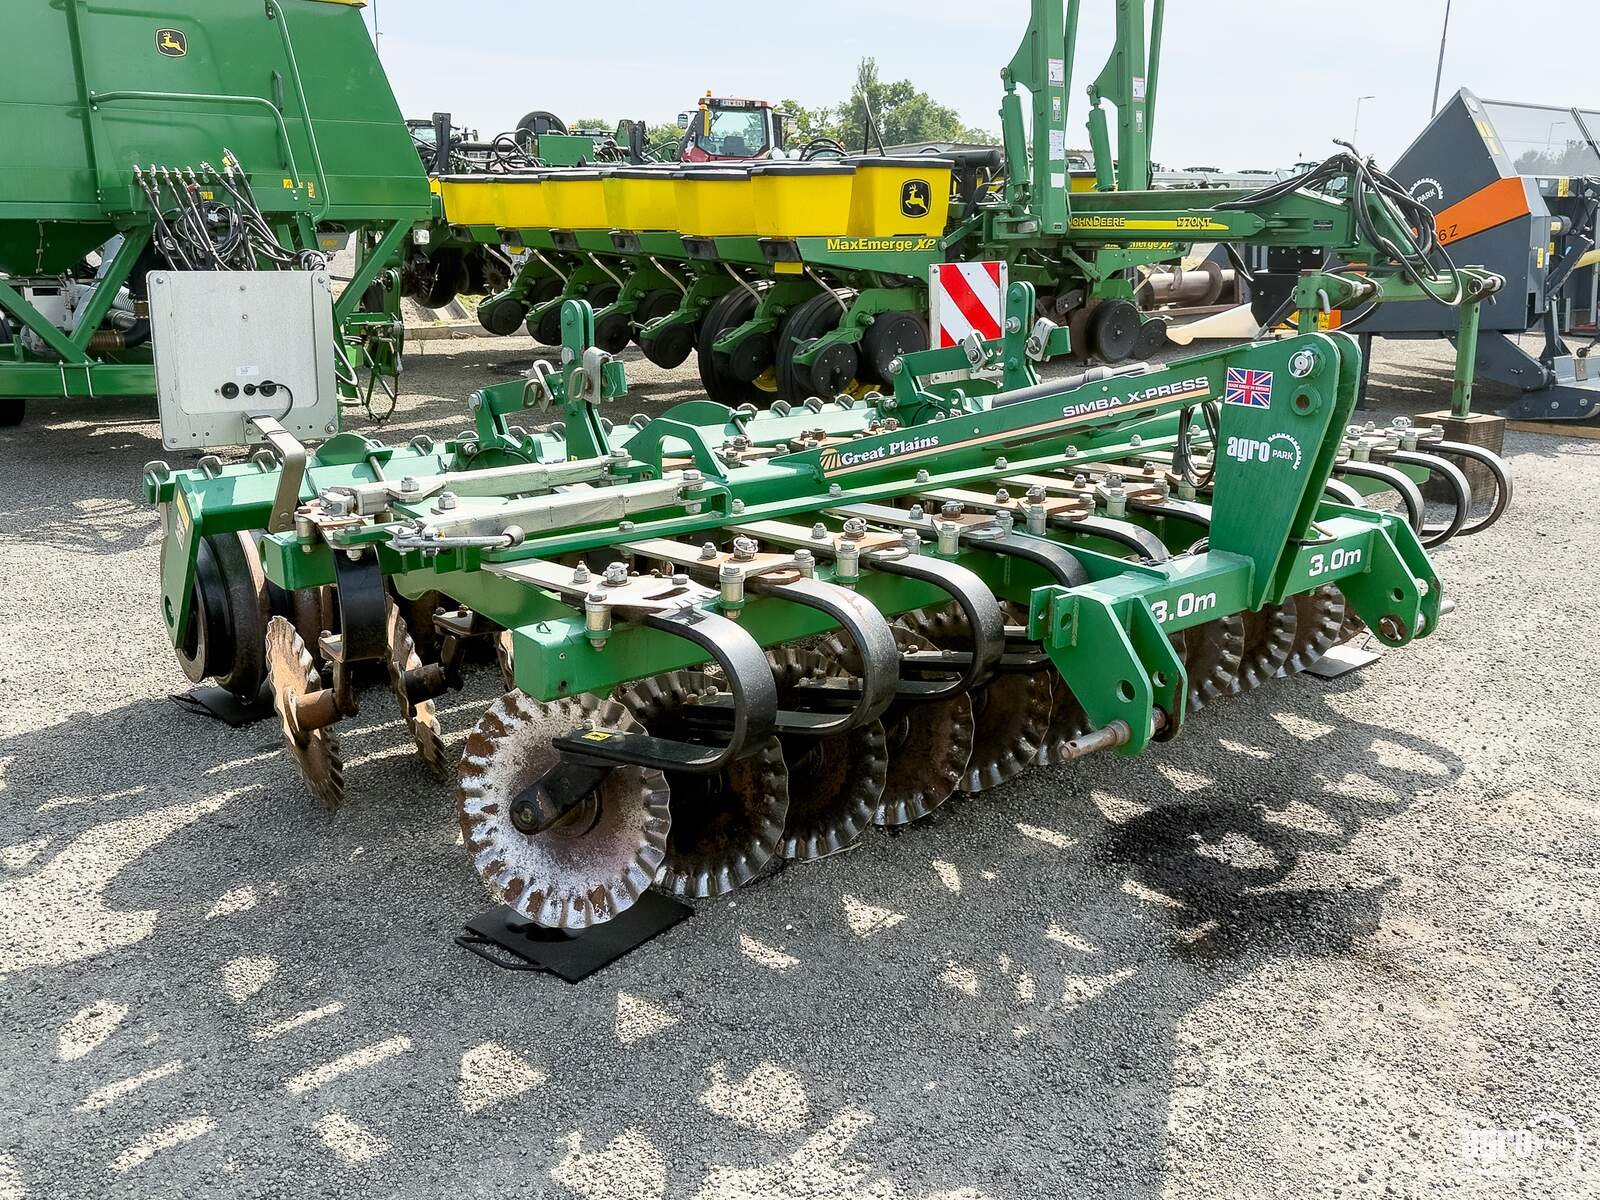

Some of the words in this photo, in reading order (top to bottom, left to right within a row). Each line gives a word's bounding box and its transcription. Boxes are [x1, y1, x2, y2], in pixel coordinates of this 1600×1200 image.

[1093, 215, 1126, 227] DEERE
[1176, 216, 1213, 229] 1770NT
[1449, 223, 1459, 238] Z
[827, 238, 914, 252] MaxEmerge
[912, 238, 937, 251] XP
[1062, 396, 1122, 417] SIMBA
[1127, 376, 1210, 404] X-PRESS
[841, 446, 885, 465] Great
[889, 435, 939, 455] Plains
[1226, 436, 1270, 462] agro
[1272, 449, 1294, 461] PARK
[1308, 548, 1362, 577] 3.0m
[1151, 591, 1217, 624] 3.0m
